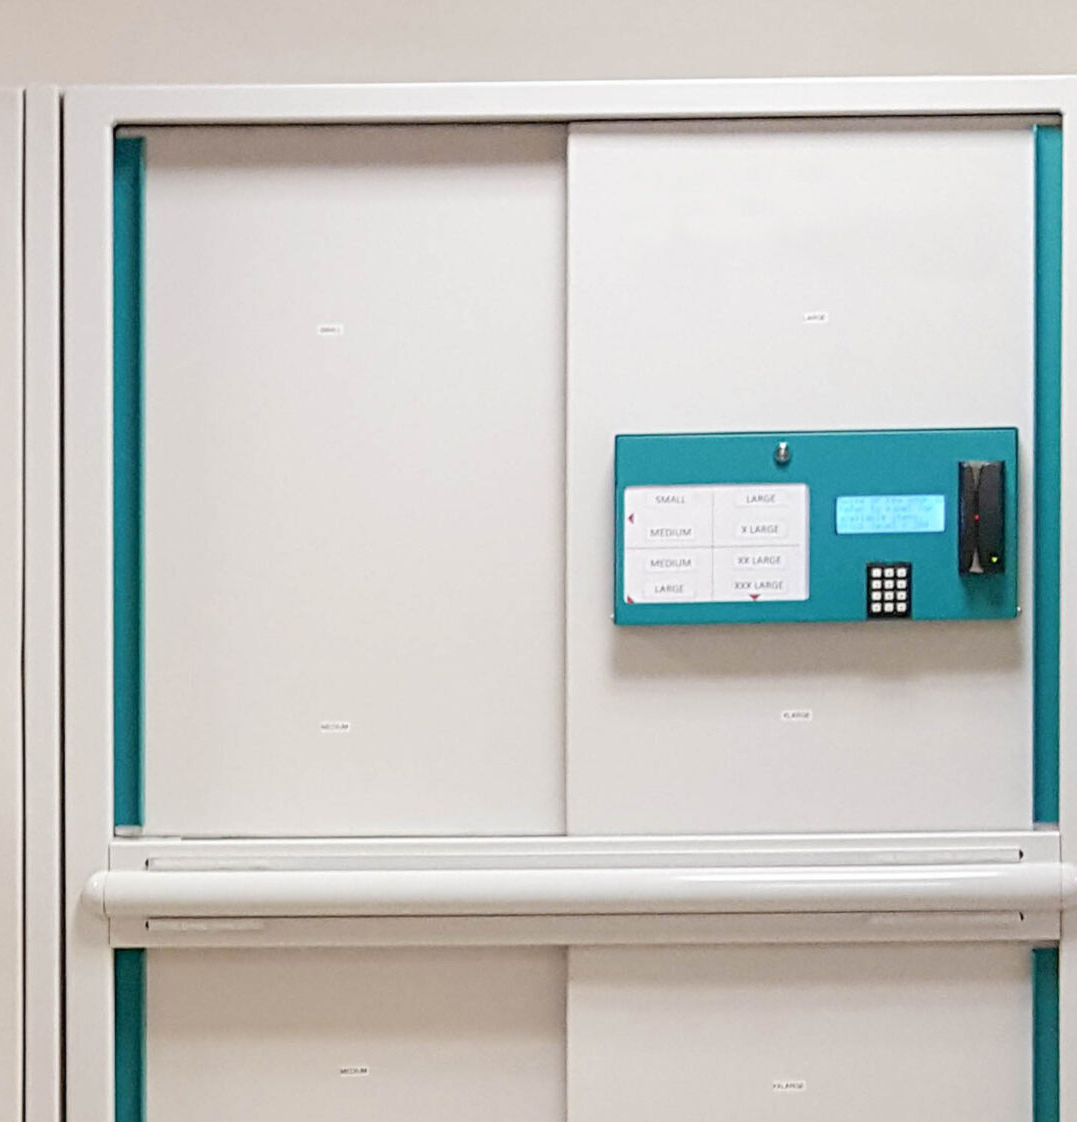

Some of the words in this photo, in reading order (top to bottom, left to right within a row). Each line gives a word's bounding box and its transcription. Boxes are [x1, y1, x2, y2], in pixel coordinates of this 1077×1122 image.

[655, 494, 685, 504] SMALL
[746, 494, 776, 503] LARGE
[650, 528, 692, 537] MEDIUM
[749, 524, 779, 534] LARGE
[650, 558, 692, 568] MEDIUM
[752, 555, 781, 565] LARGE
[654, 584, 684, 594] LARGE
[754, 580, 784, 590] LARGE
